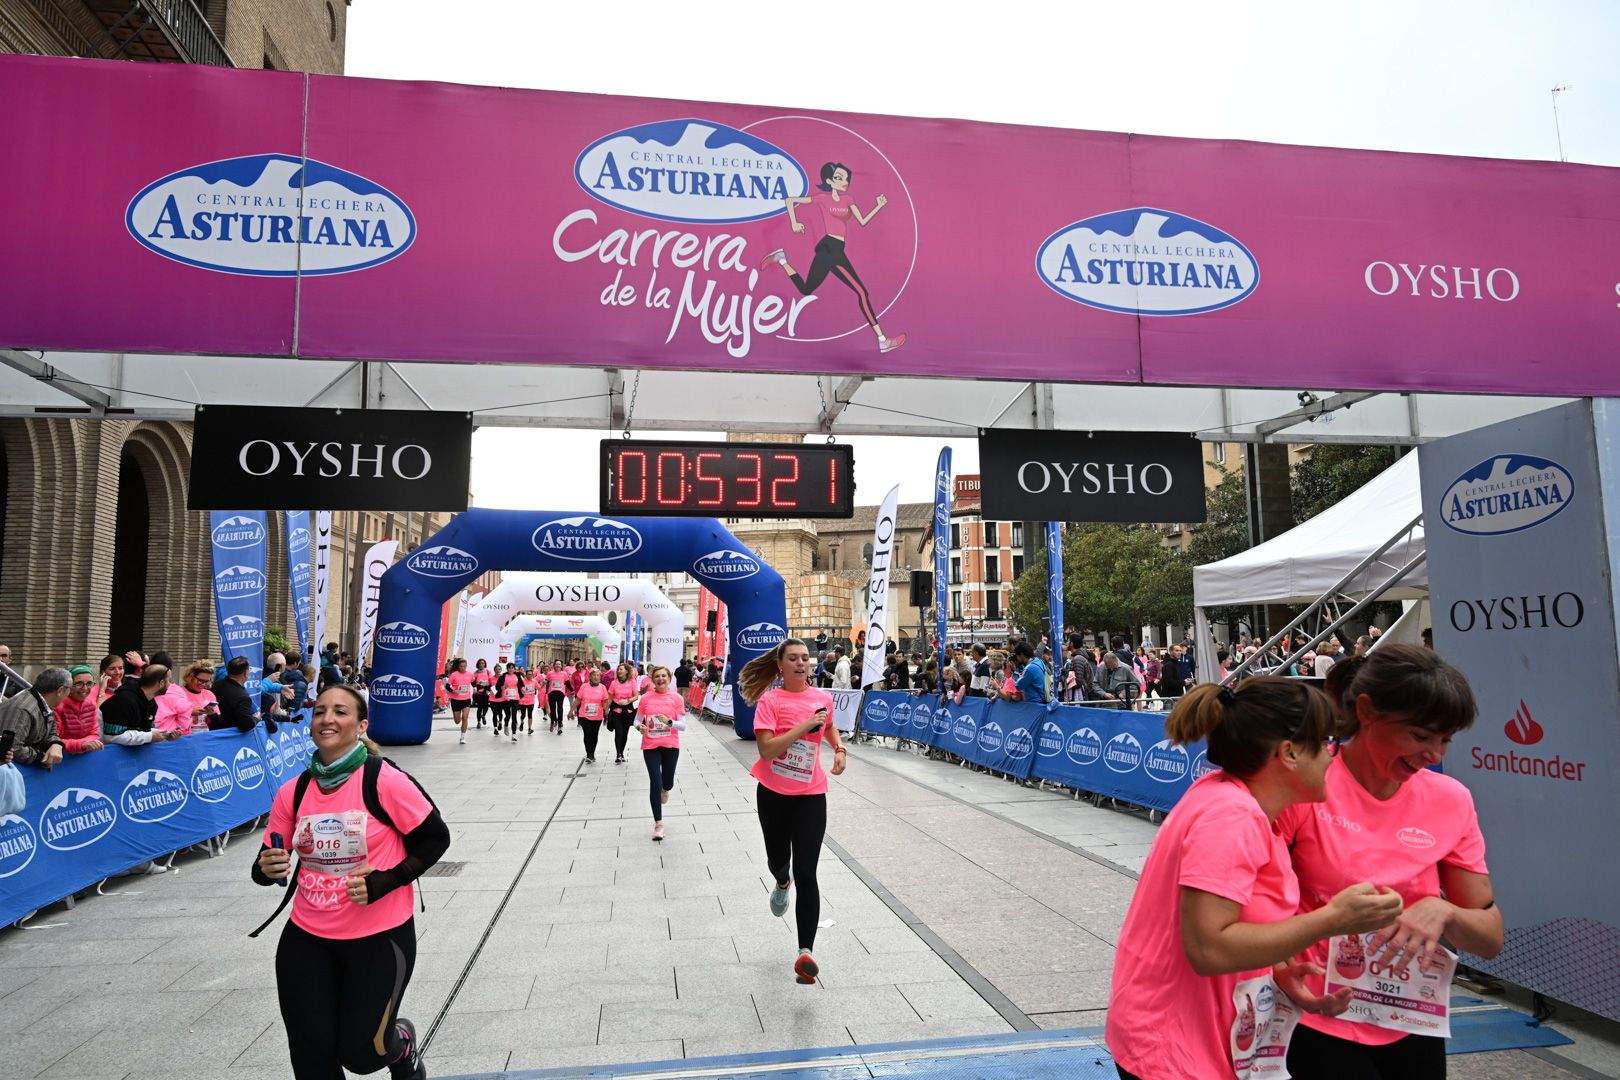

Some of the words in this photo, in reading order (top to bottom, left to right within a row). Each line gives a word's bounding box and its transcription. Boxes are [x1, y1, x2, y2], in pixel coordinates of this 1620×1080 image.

[631, 151, 704, 166] CENTRAL
[711, 156, 784, 171] LECHERA
[593, 152, 790, 201] ASTURIANA
[196, 193, 286, 208] CENTRAL
[295, 197, 386, 213] LECHERA
[148, 194, 394, 249] ASTURIANA
[552, 209, 746, 273] Carrera
[1088, 241, 1158, 256] CENTRAL
[1165, 245, 1236, 259] LECHERA
[1054, 243, 1244, 291] ASTURIANA
[1364, 260, 1520, 302] OYSHO
[600, 268, 636, 307] de
[645, 270, 671, 310] la
[664, 268, 818, 358] Mujer
[238, 439, 432, 480] OYSHO
[957, 481, 981, 491] TIBU
[1017, 460, 1173, 496] OYSHO
[1465, 481, 1506, 496] CENTRAL
[1509, 471, 1556, 488] LECHERA
[1449, 483, 1565, 522] ASTURIANA
[540, 529, 634, 551] ASTURIANA
[411, 556, 473, 571] ASTURIANA
[699, 562, 756, 574] ASTURIANA
[535, 584, 621, 602] OYSHO
[867, 516, 893, 651] OYSHO
[482, 603, 510, 611] OYSHO
[643, 602, 669, 610] OYSHO
[1450, 591, 1584, 632] OYSHO
[469, 637, 495, 645] OYSHO
[1105, 745, 1139, 765] ASTURIANA
[1146, 752, 1186, 774] ASTURIANA
[1471, 746, 1586, 782] Santander
[128, 788, 186, 816] ASTURIANA
[47, 807, 113, 843] ASTURIANA
[53, 808, 79, 821] CENTRAL
[316, 839, 341, 850] 016
[1369, 960, 1410, 981] 016
[1375, 981, 1401, 994] 3021
[1373, 994, 1383, 1003] DE
[1384, 996, 1394, 1005] LA
[1394, 998, 1418, 1010] MUJER
[1399, 1013, 1441, 1030] Santander
